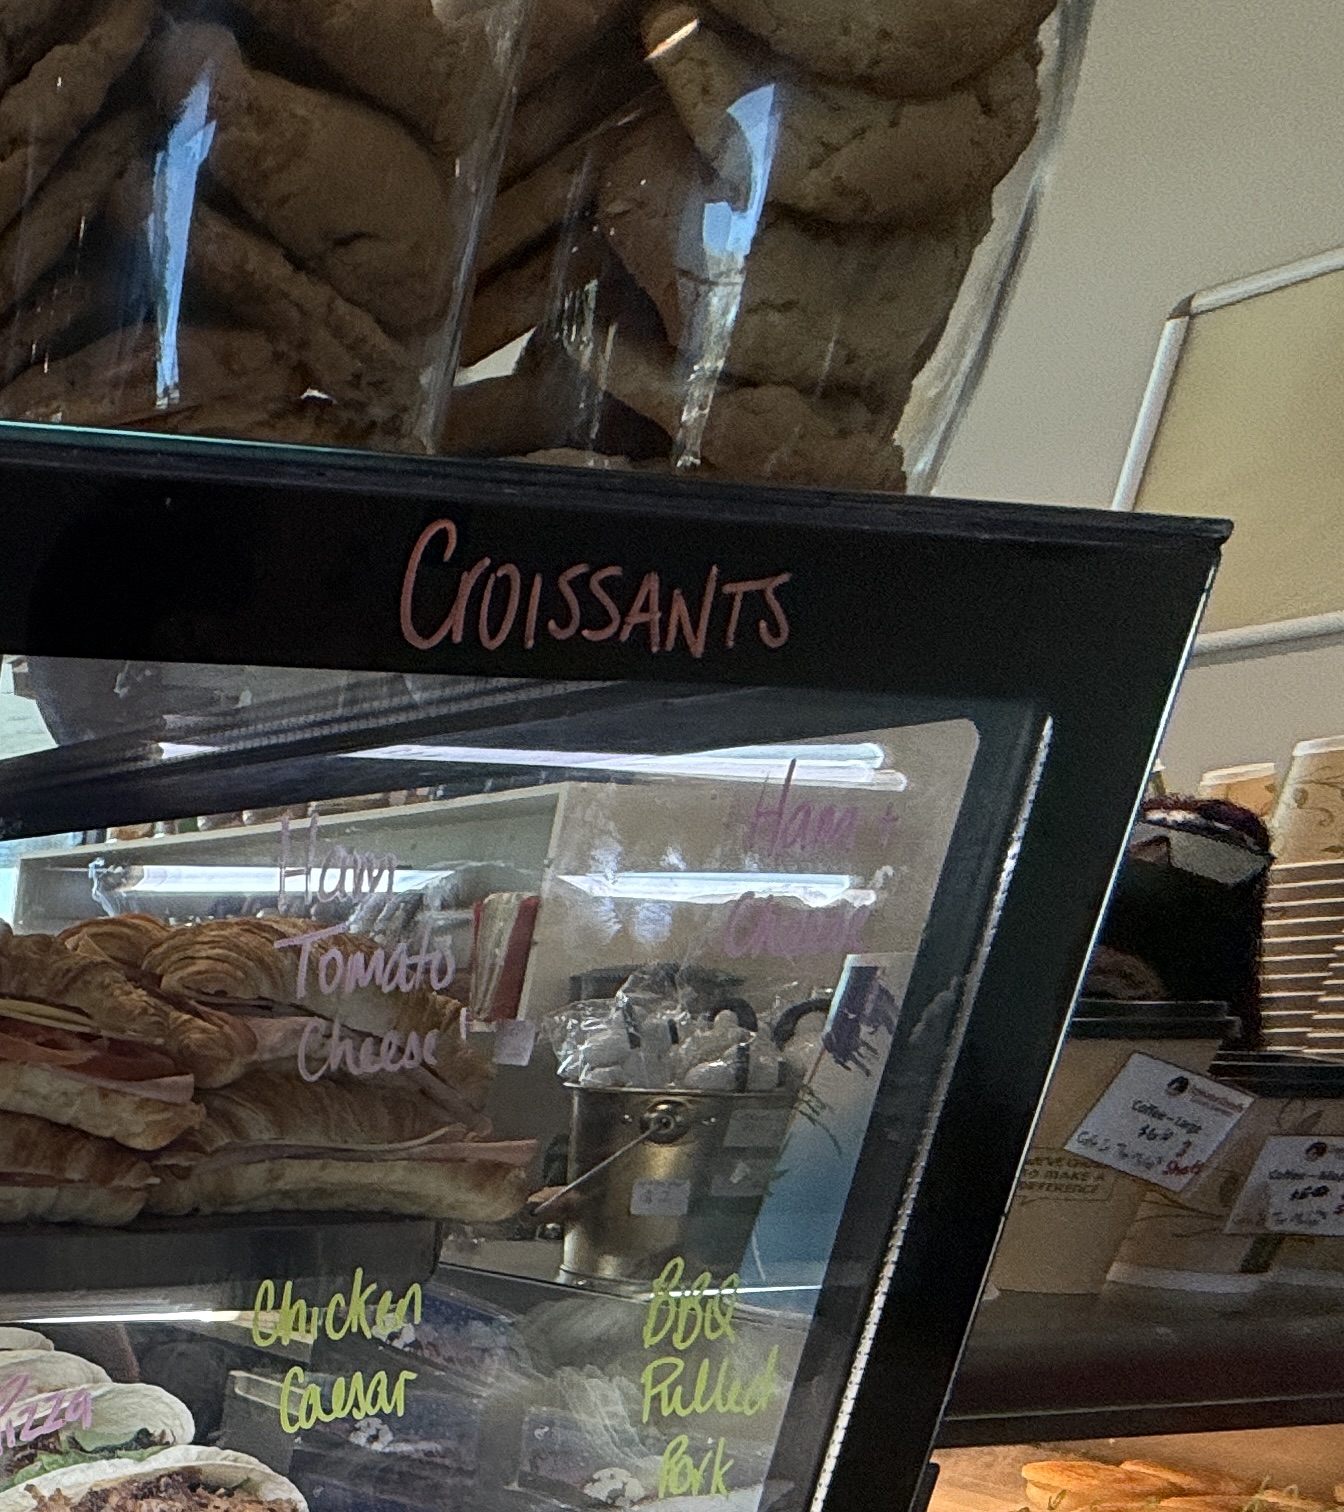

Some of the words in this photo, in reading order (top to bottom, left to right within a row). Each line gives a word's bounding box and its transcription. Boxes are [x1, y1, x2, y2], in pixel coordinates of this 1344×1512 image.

[277, 808, 399, 916] Ham
[273, 920, 457, 1001] Tomato
[297, 1007, 440, 1083] Cheese
[252, 1267, 423, 1348] Chicken
[279, 1366, 418, 1434] Caesar
[641, 1345, 782, 1423] Pulled
[657, 1433, 735, 1500] Pork
